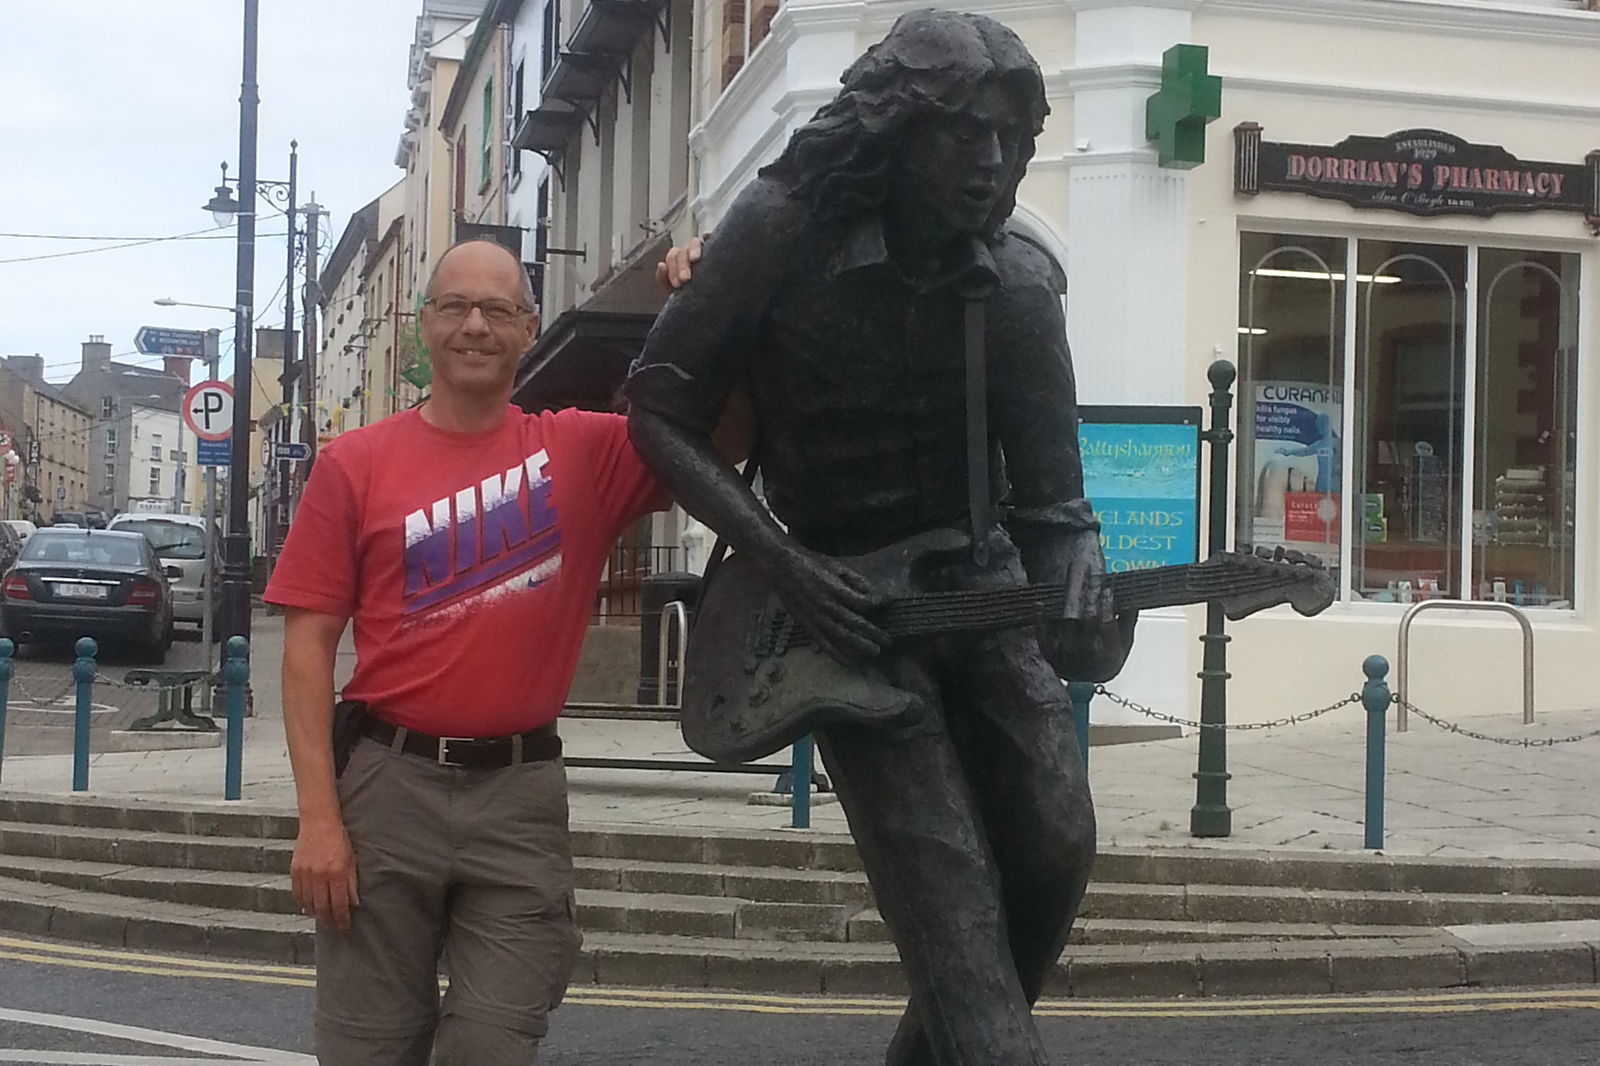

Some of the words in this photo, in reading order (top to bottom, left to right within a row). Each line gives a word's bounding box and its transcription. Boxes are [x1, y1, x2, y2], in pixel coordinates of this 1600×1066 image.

[1288, 155, 1423, 187] DORRIAN'S
[1434, 165, 1564, 195] PHARMACY
[203, 391, 224, 430] P
[402, 447, 558, 600] NIKE
[1092, 510, 1185, 527] ELANDS
